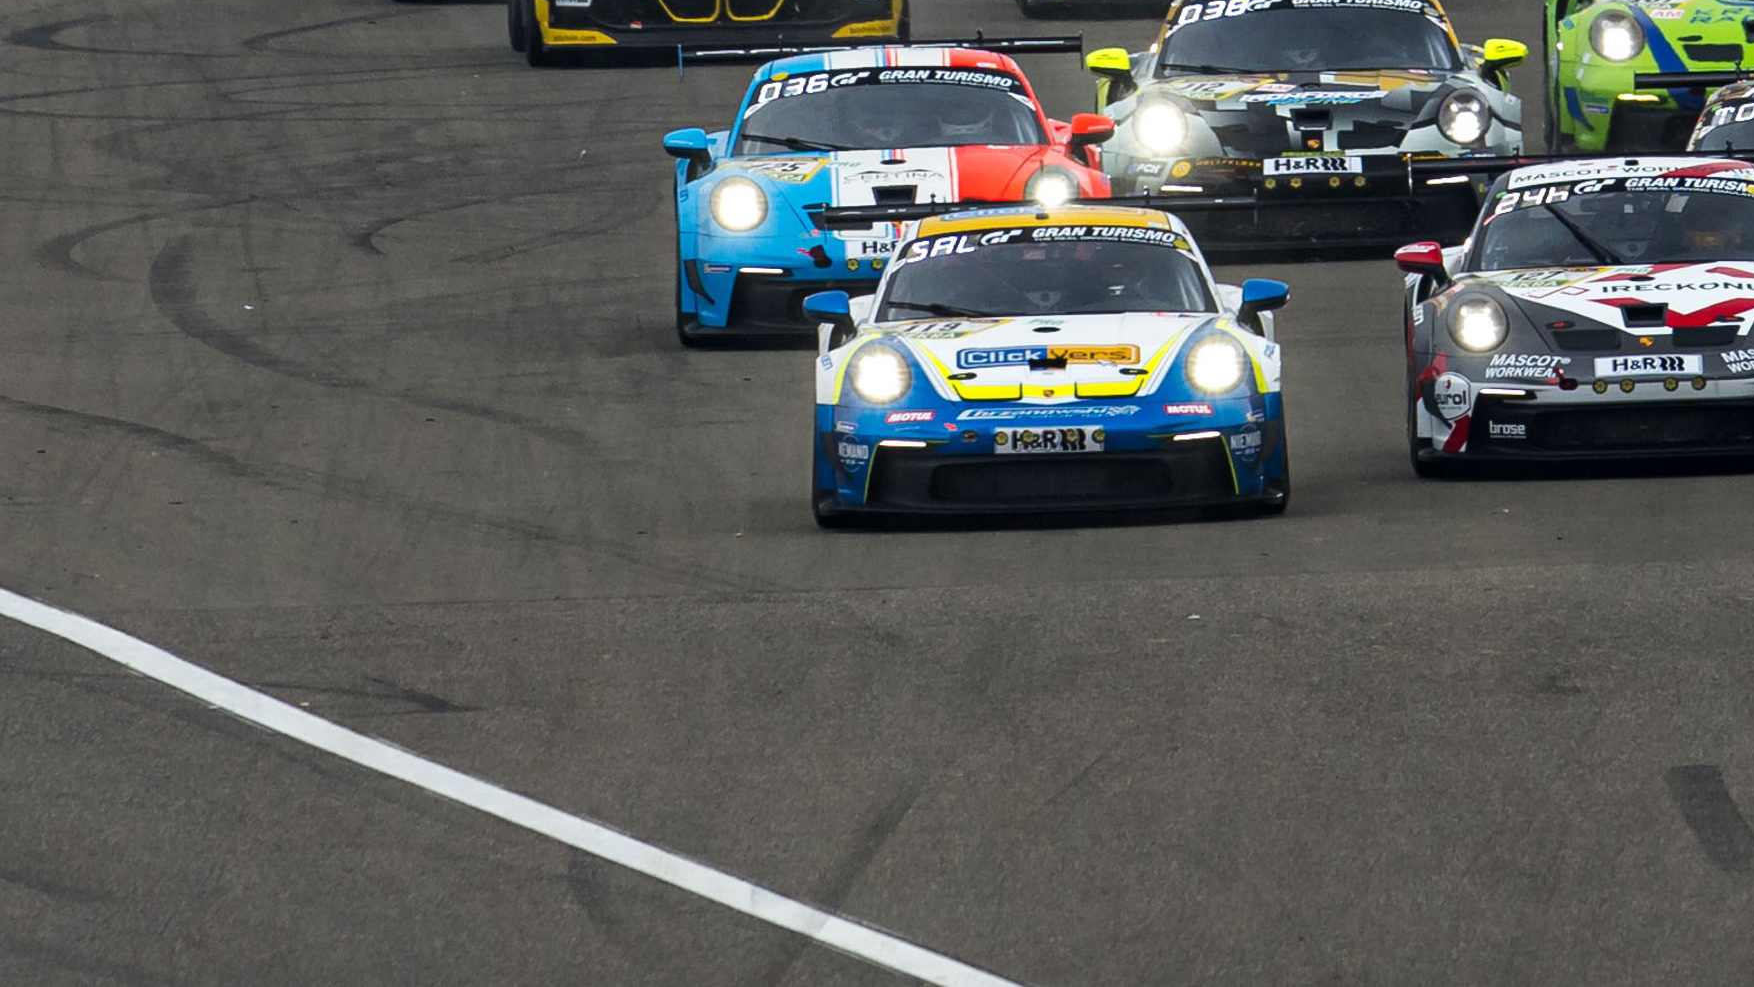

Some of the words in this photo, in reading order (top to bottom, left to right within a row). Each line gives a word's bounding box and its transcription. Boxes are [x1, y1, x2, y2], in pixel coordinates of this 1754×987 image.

[878, 69, 932, 82] GRAN
[934, 70, 1015, 89] TURISMO
[1624, 177, 1682, 190] GRAN
[1031, 226, 1089, 239] GRAN
[1091, 226, 1176, 244] TURISMO
[1166, 404, 1212, 414] MOTUL
[887, 411, 934, 423] MOTUL
[1488, 420, 1526, 435] brose
